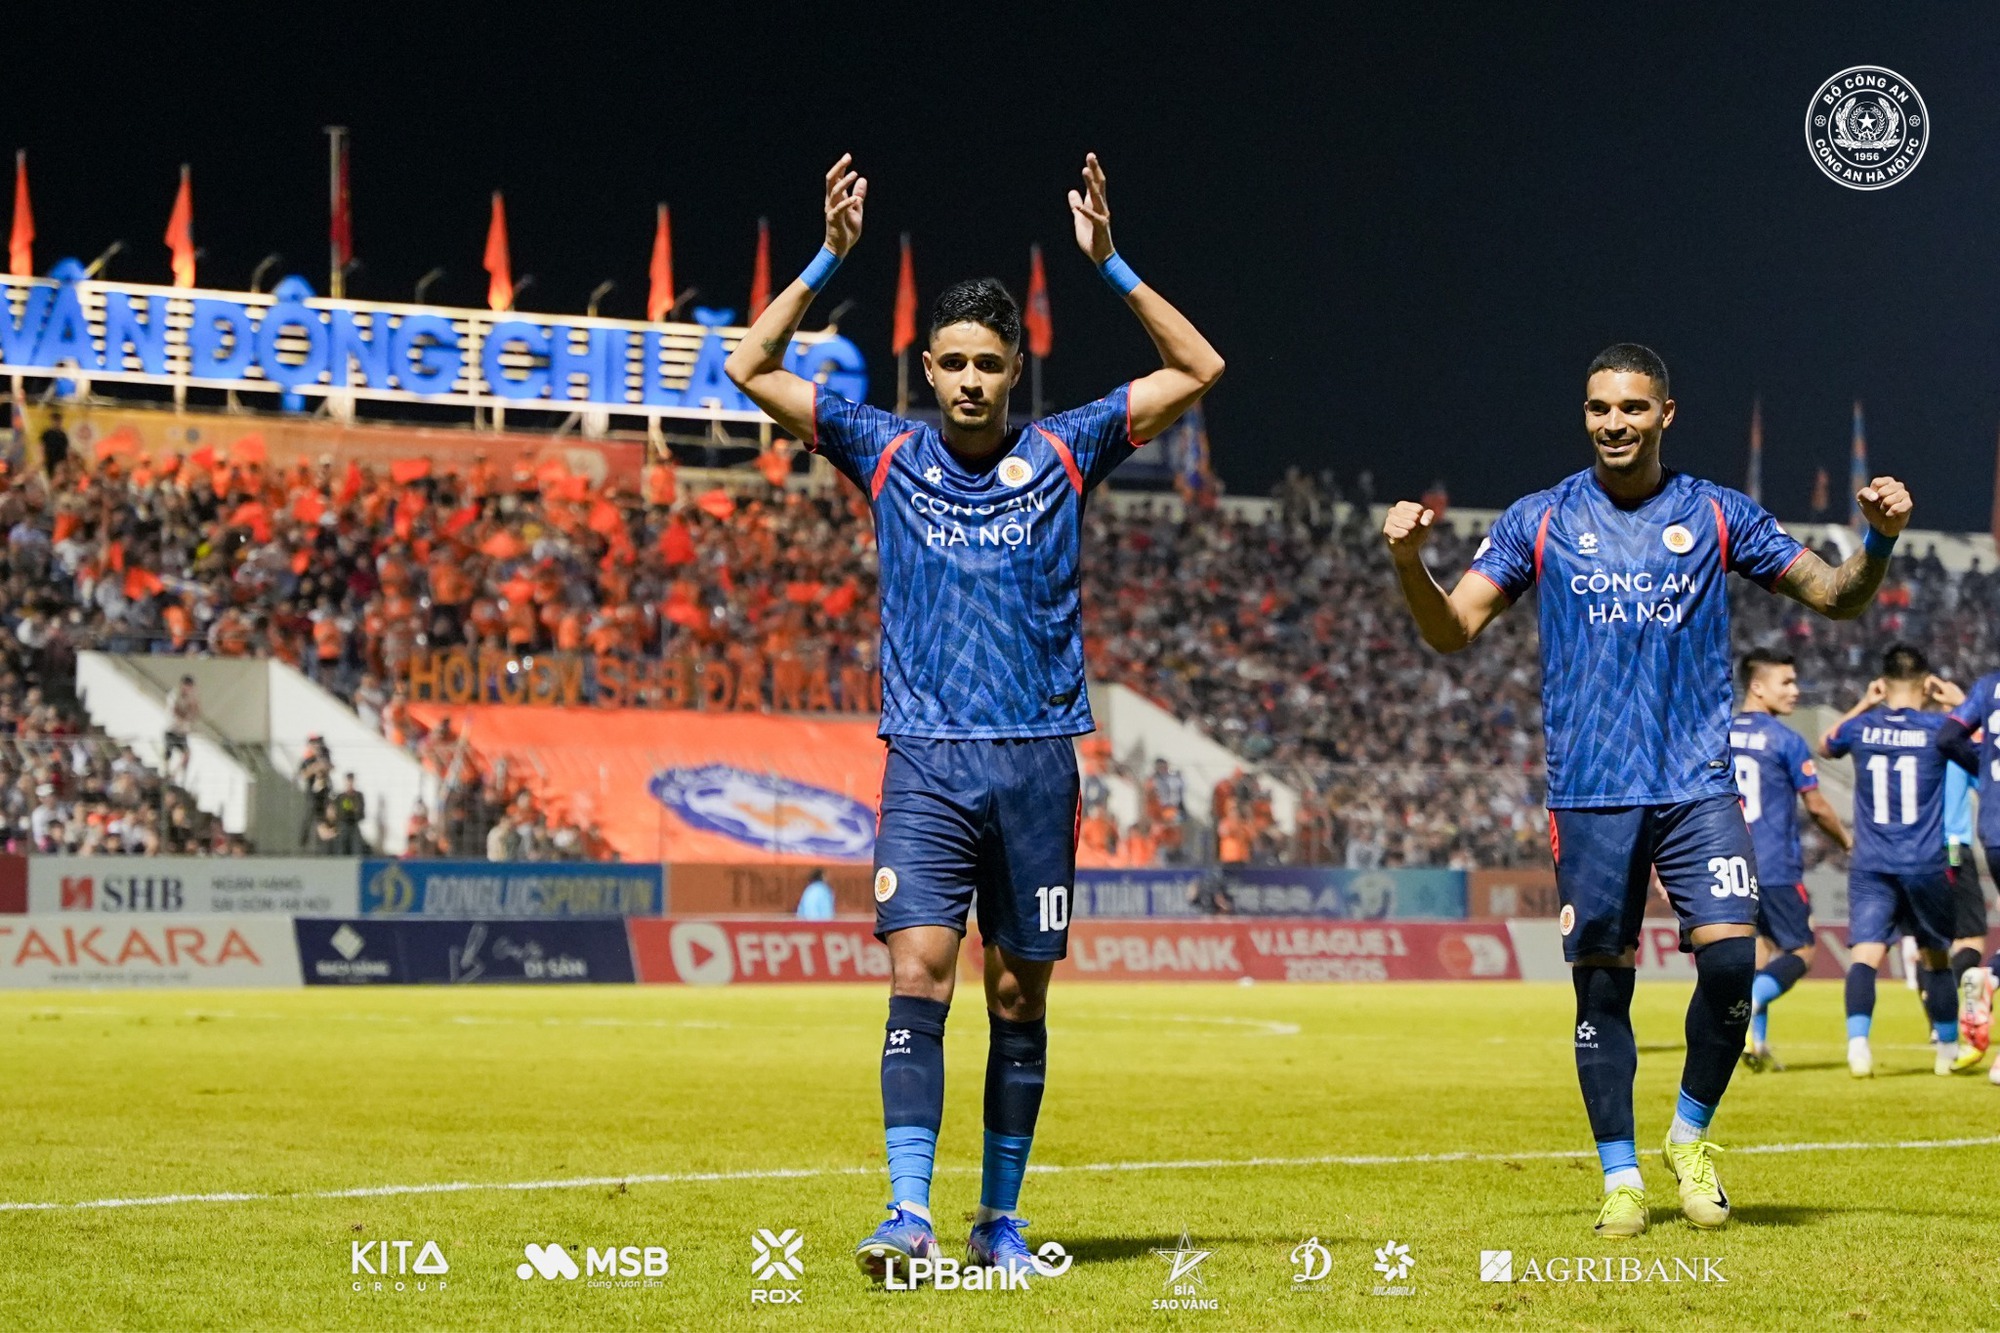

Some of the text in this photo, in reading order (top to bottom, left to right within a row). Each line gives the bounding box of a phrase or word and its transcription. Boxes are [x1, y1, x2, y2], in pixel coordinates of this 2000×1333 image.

[188, 275, 461, 412] ĐỘNG
[482, 320, 625, 405] CHI
[643, 306, 869, 412] LĂG
[1005, 491, 1046, 512] AN
[926, 517, 1032, 551] HÀ NỘI
[1570, 569, 1697, 595] CÔNG AN
[1589, 597, 1683, 627] HÀ NỘI
[1866, 755, 1919, 825] 11
[102, 875, 185, 913] SHB
[1707, 855, 1750, 898] 30
[1034, 885, 1068, 932] 10
[735, 931, 893, 977] FPT Pla
[1071, 936, 1244, 972] LPBANK
